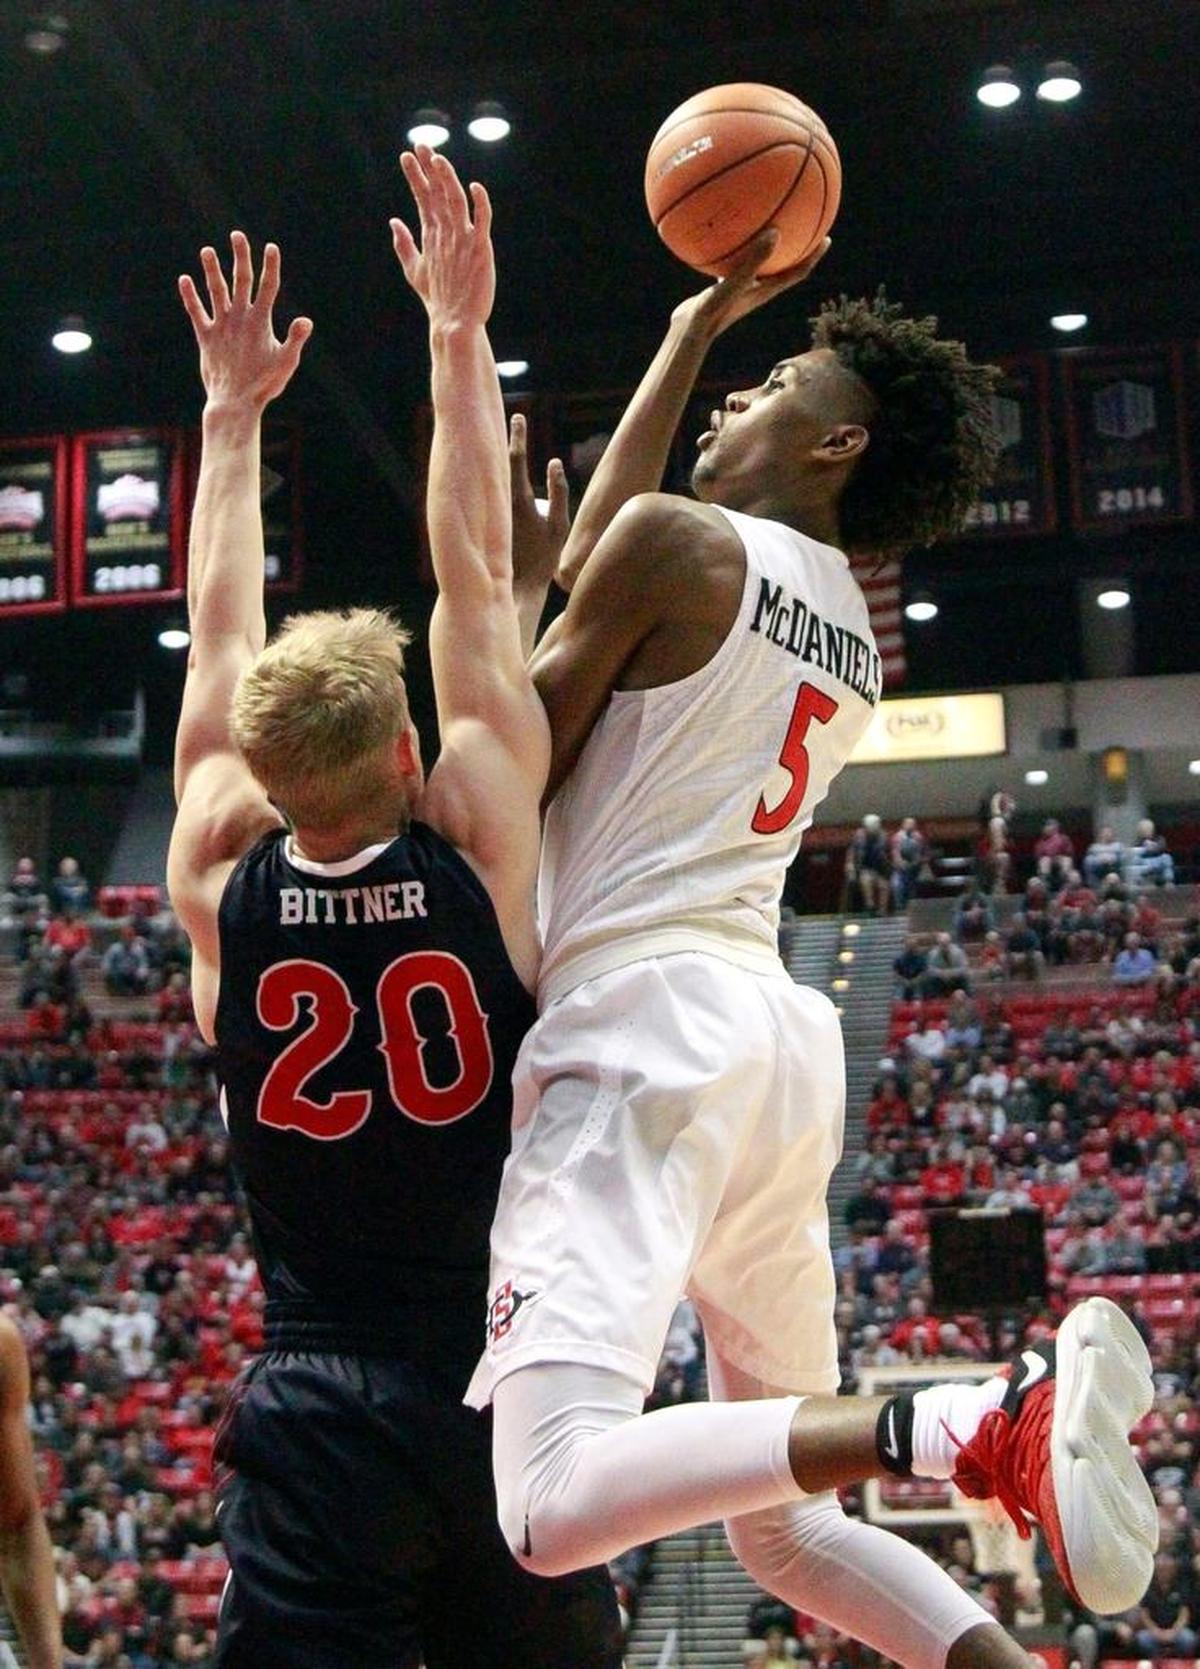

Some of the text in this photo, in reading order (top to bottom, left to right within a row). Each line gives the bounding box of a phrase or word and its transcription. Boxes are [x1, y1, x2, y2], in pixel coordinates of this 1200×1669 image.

[751, 681, 839, 835] 5
[279, 881, 428, 925] BITTNER
[256, 950, 495, 1141] 20
